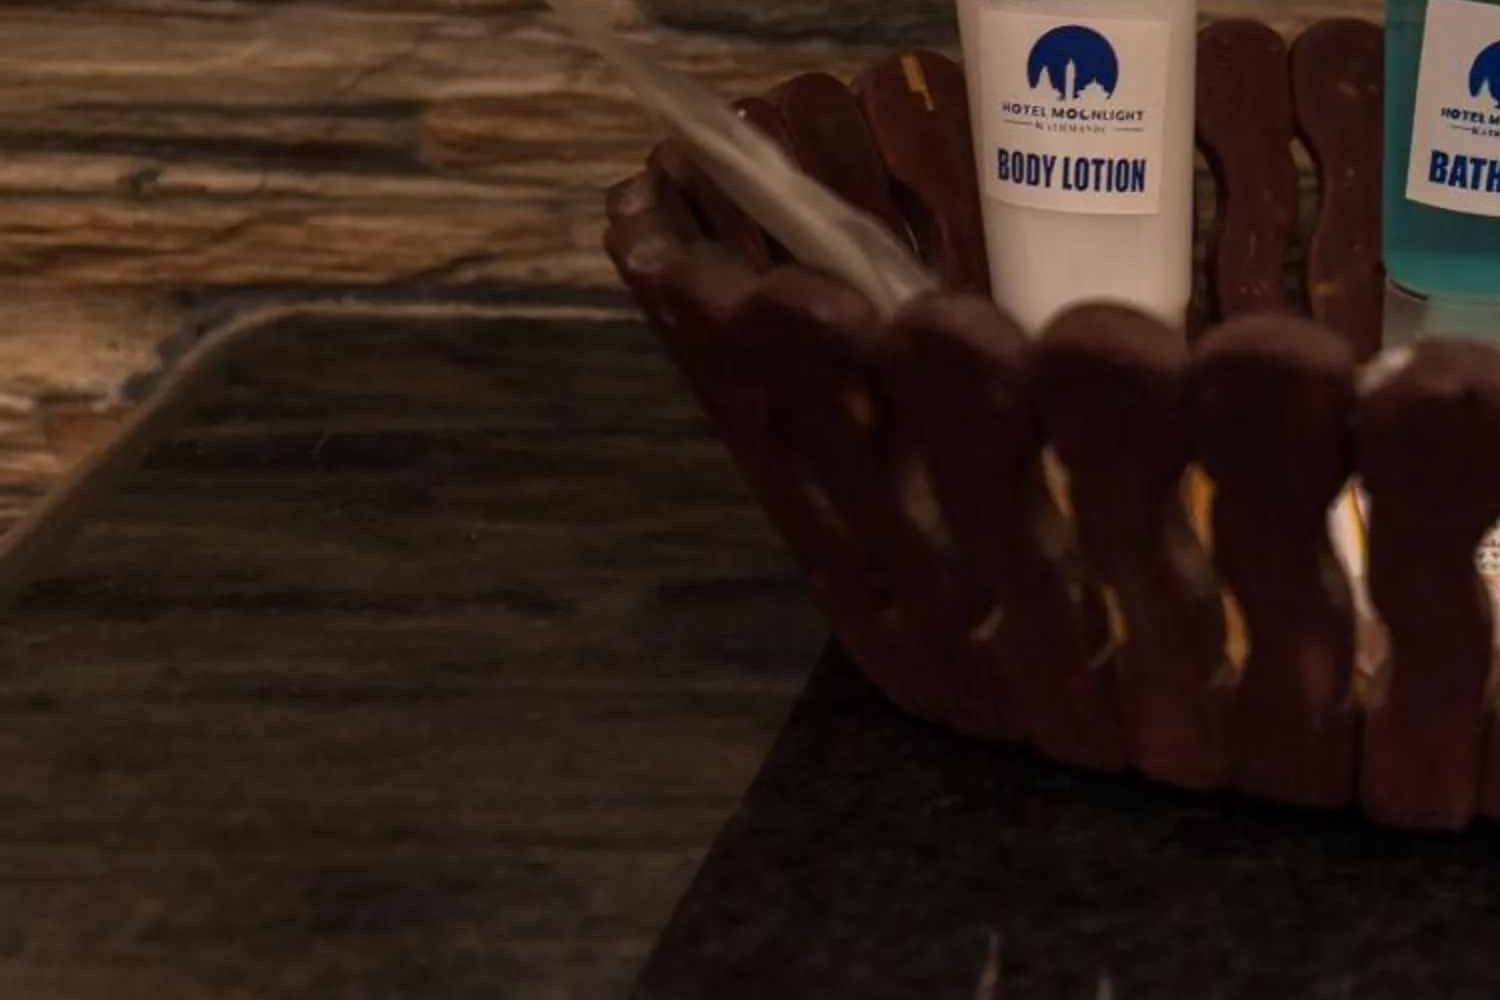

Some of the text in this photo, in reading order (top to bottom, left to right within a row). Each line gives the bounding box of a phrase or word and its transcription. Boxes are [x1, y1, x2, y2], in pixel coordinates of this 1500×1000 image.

[1001, 102, 1047, 118] HOTEL
[1441, 106, 1485, 124] HOTEL
[997, 147, 1146, 193] BODY LOTION
